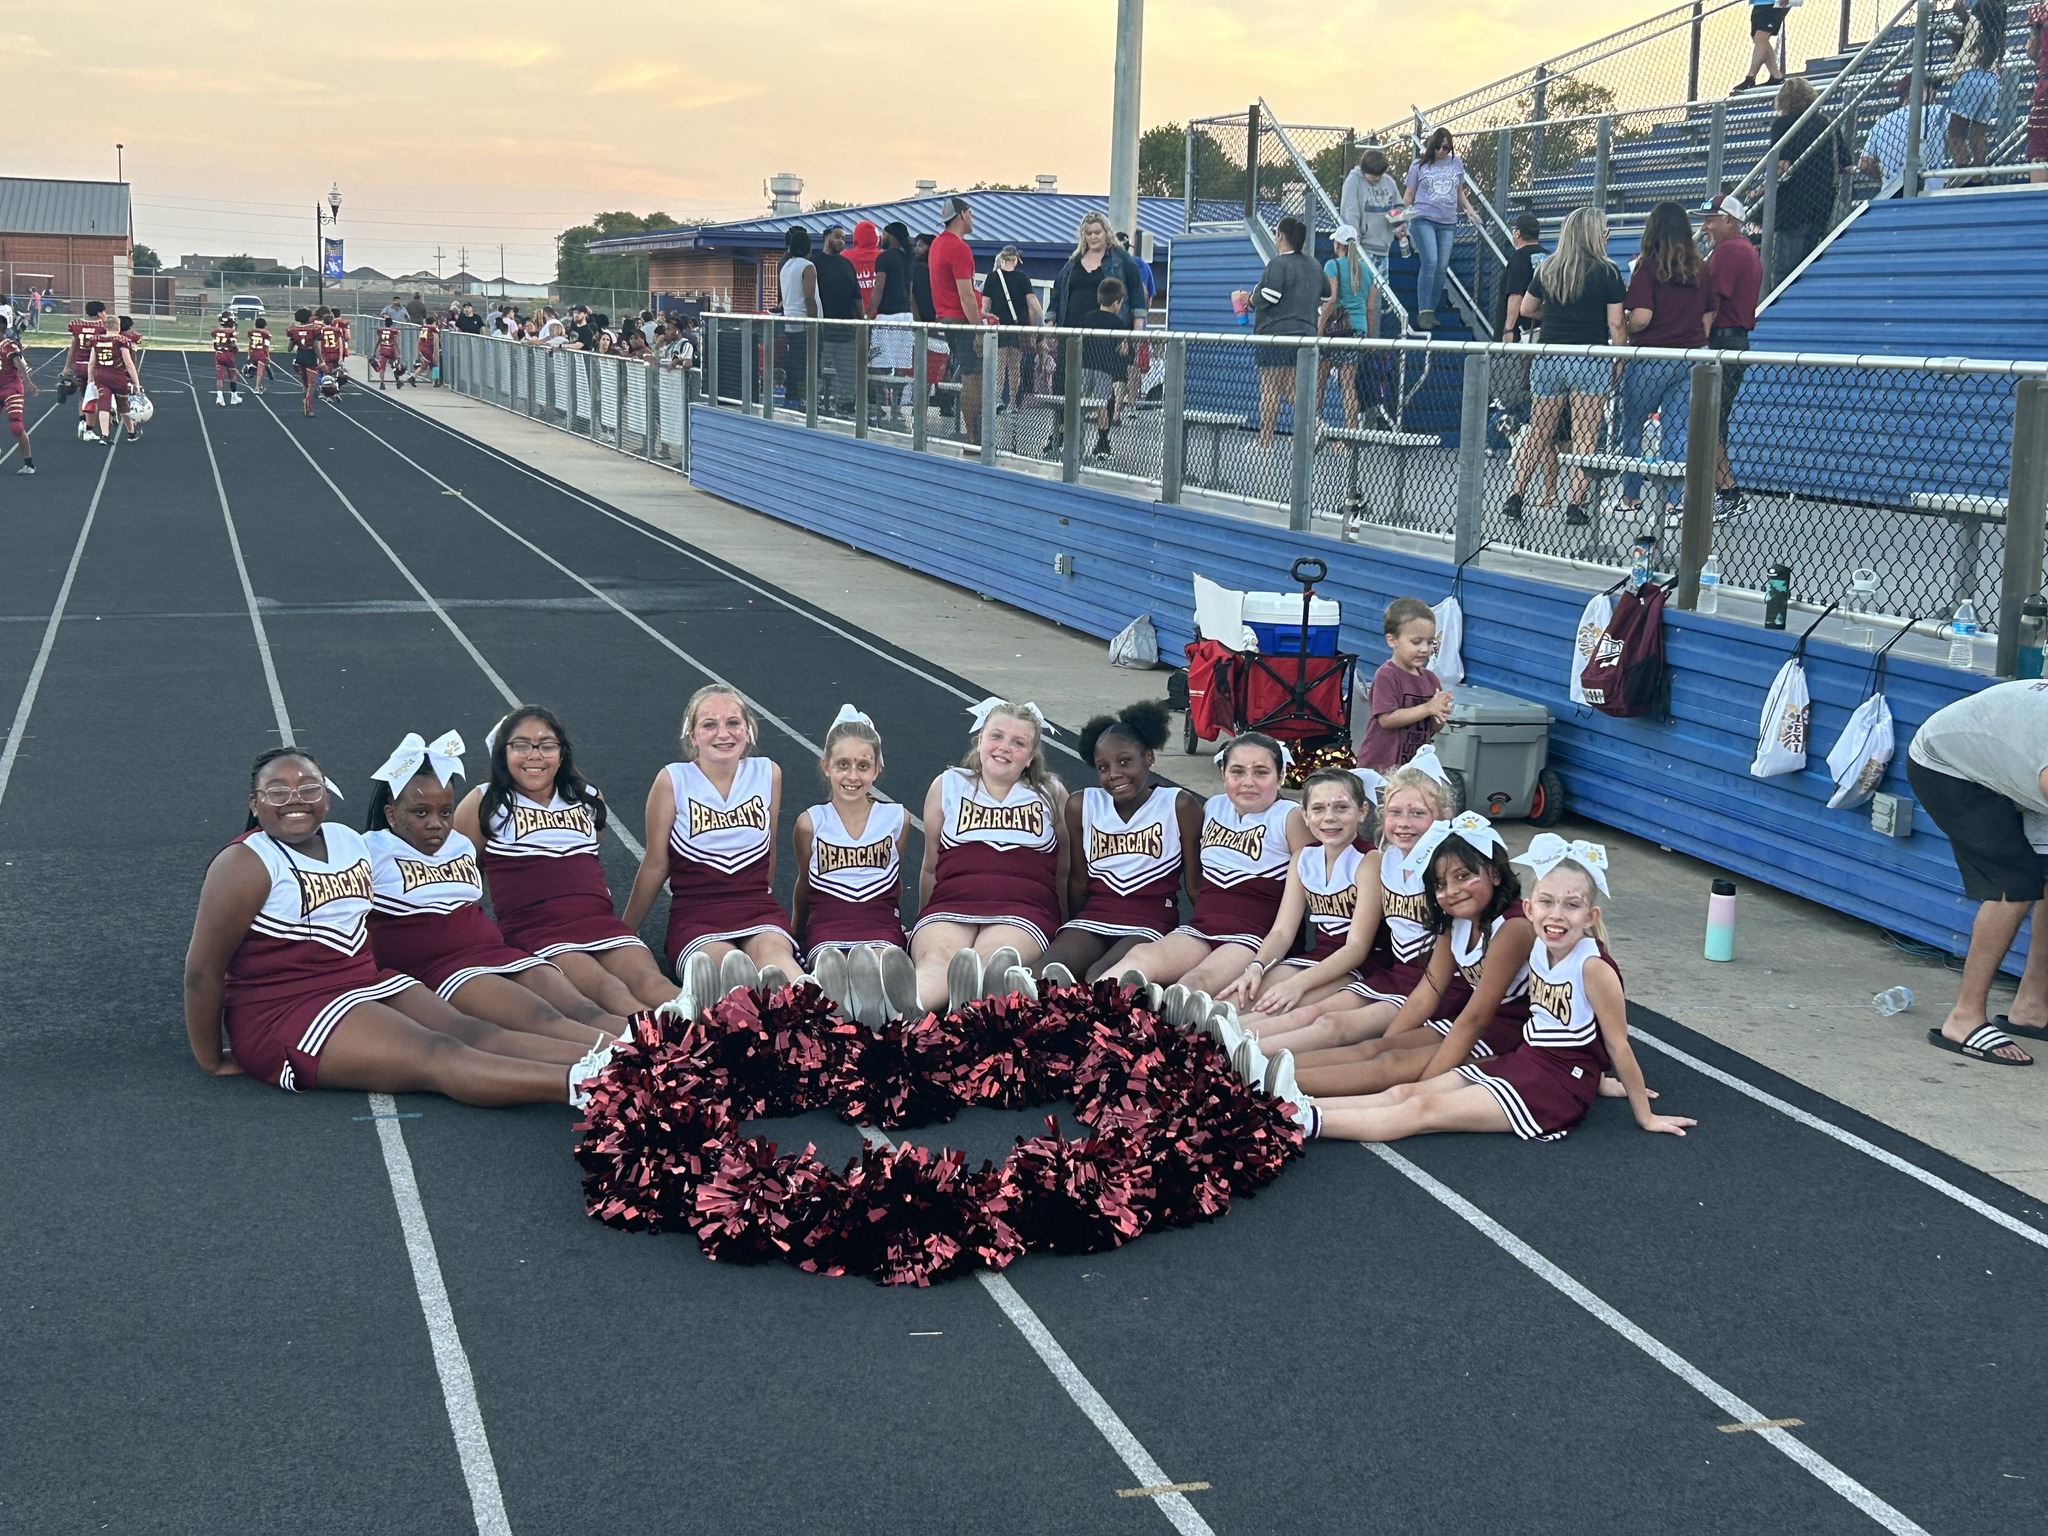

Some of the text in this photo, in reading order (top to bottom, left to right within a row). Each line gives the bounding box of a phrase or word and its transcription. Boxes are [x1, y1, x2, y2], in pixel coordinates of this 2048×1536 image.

[512, 804, 592, 842] BEARCATS
[688, 797, 766, 839] BEARCATS
[956, 797, 1043, 837] BEARCATS
[816, 836, 893, 877] BEARCATS
[1090, 822, 1163, 864] BEARCATS
[290, 858, 374, 917] BEARCATS
[394, 854, 480, 894] BEARCATS
[1382, 885, 1427, 923] EARCAT
